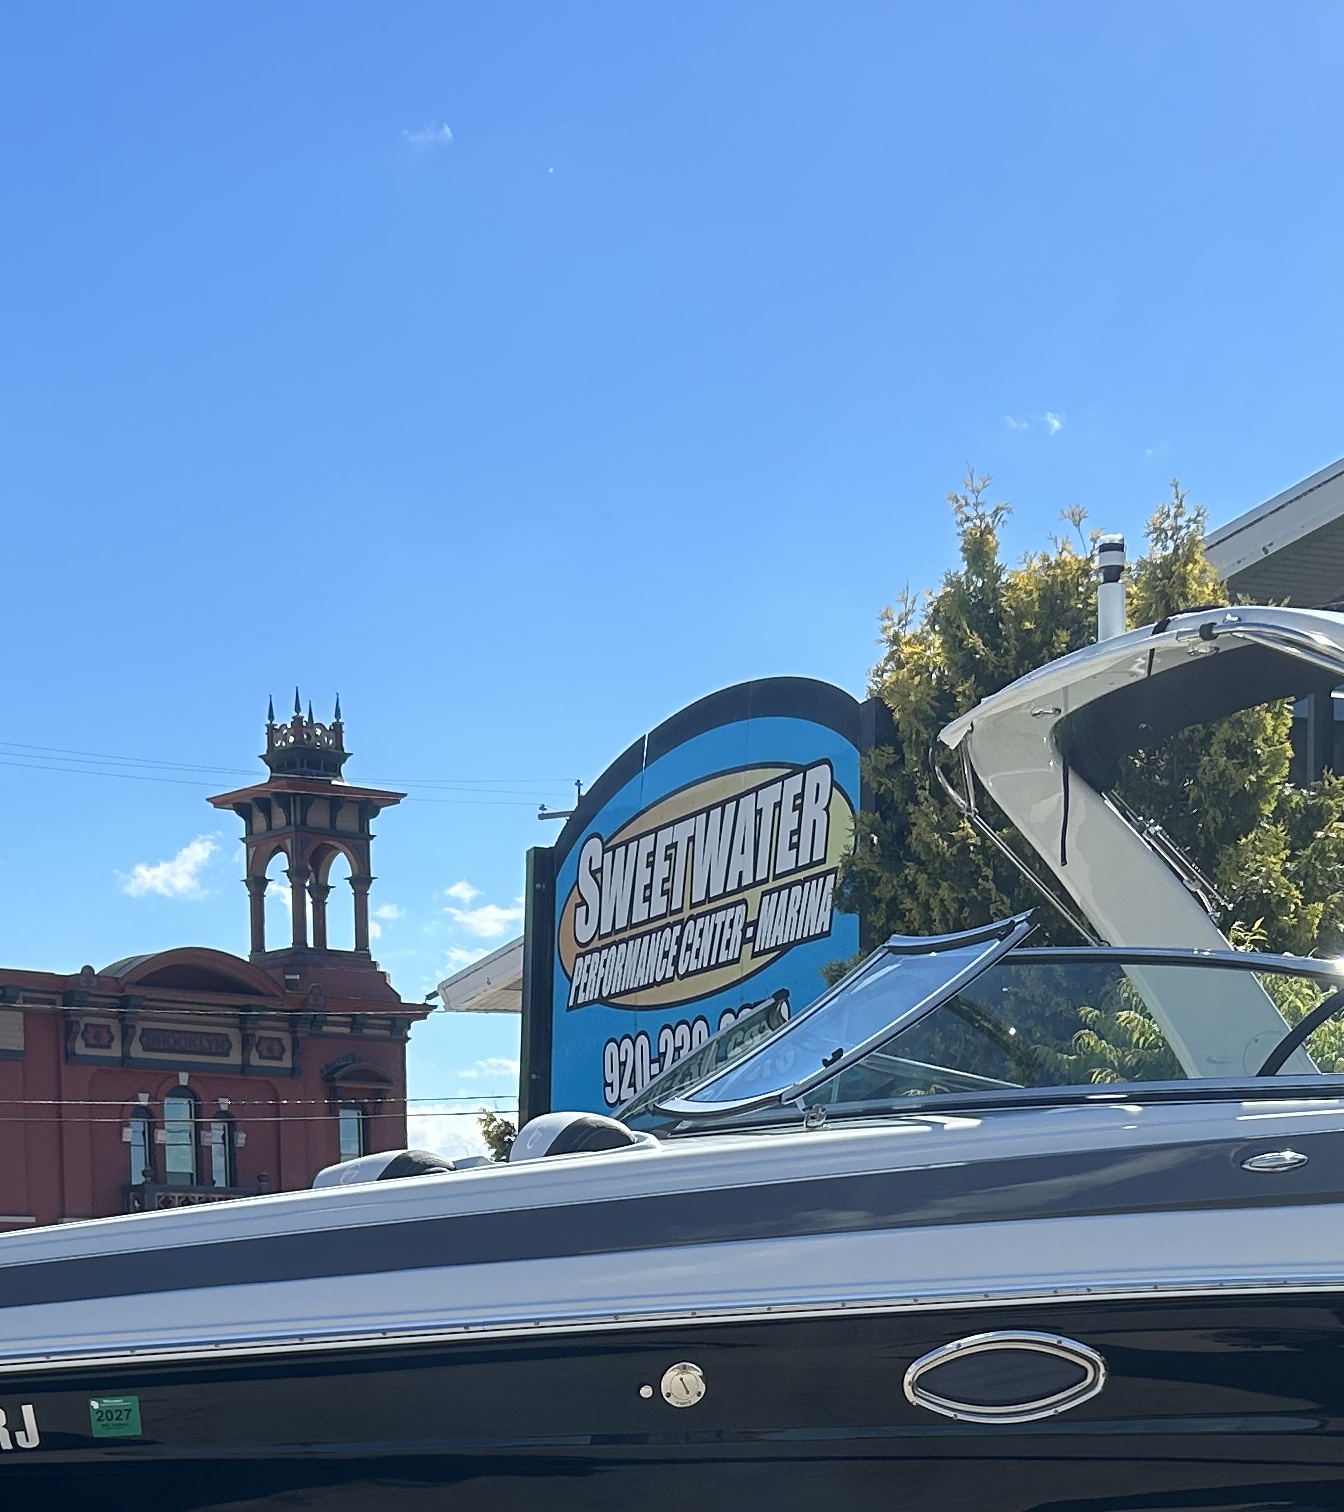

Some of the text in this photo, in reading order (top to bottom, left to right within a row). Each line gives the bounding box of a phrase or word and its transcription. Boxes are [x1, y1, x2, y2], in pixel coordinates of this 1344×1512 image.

[574, 763, 833, 945] SWEETWATER
[567, 923, 682, 1009] PERFORMANCE
[677, 902, 746, 975] CENTER
[754, 872, 838, 952] MARINA
[96, 1408, 132, 1422] 2027
